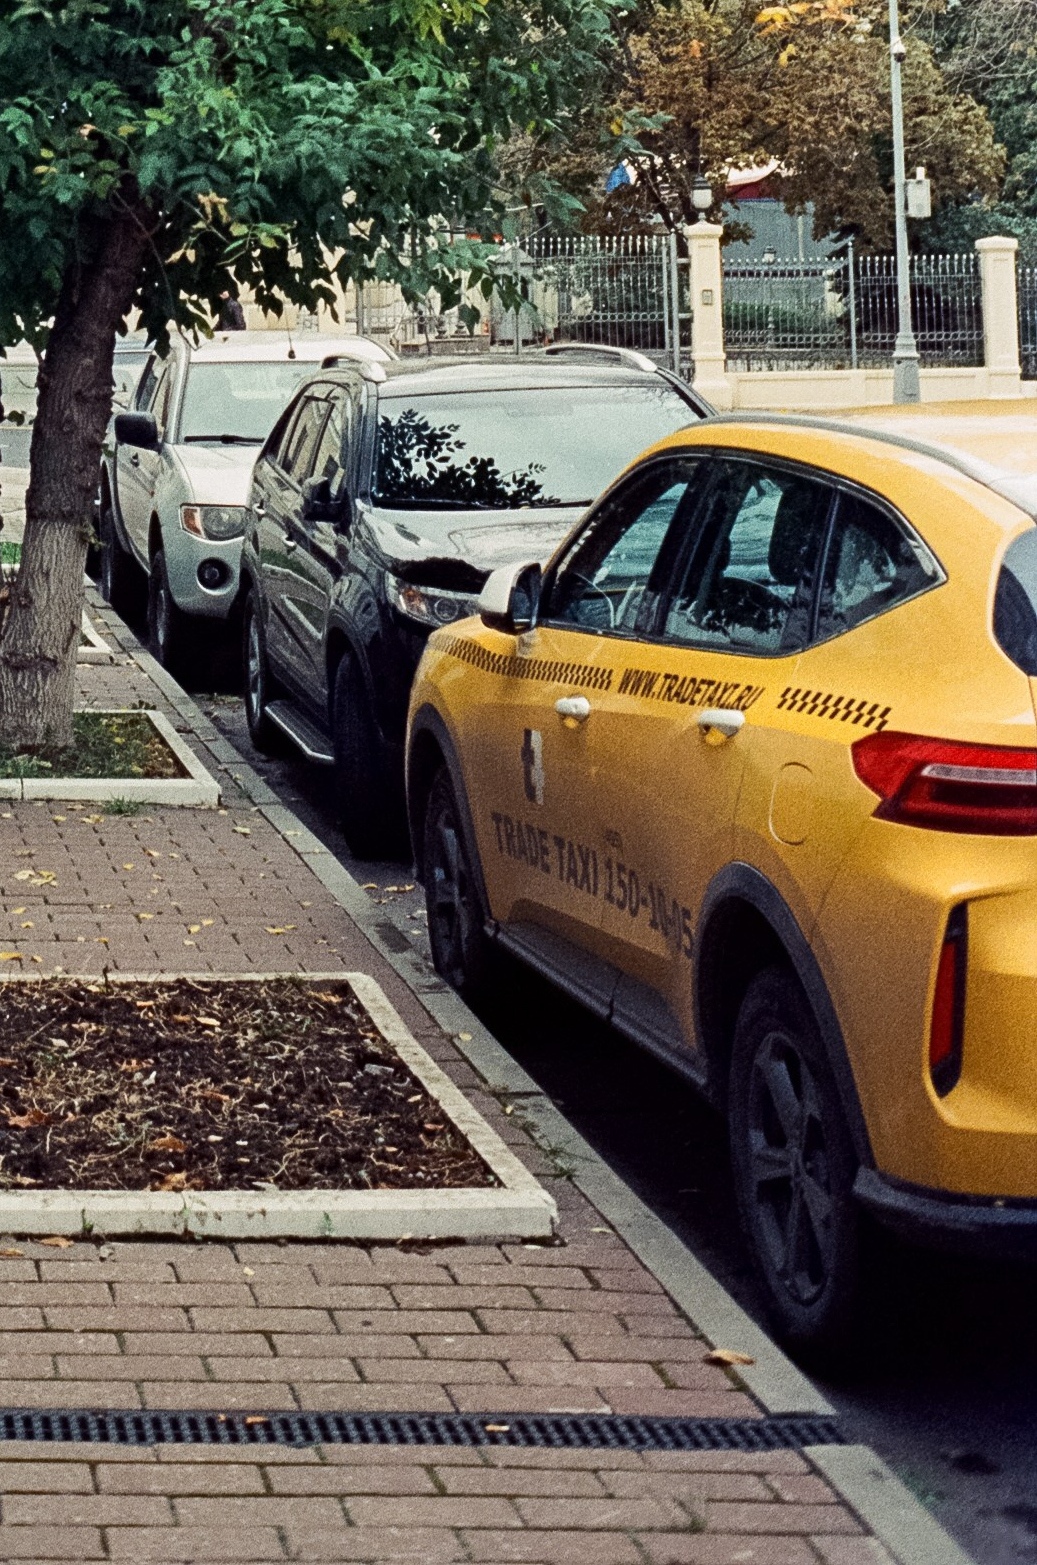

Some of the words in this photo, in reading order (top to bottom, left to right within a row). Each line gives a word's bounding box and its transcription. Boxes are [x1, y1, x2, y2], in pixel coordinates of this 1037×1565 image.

[617, 668, 766, 711] WWW.TRADETAXI.RU
[490, 811, 551, 875] TRADE
[553, 835, 598, 897] TAXI
